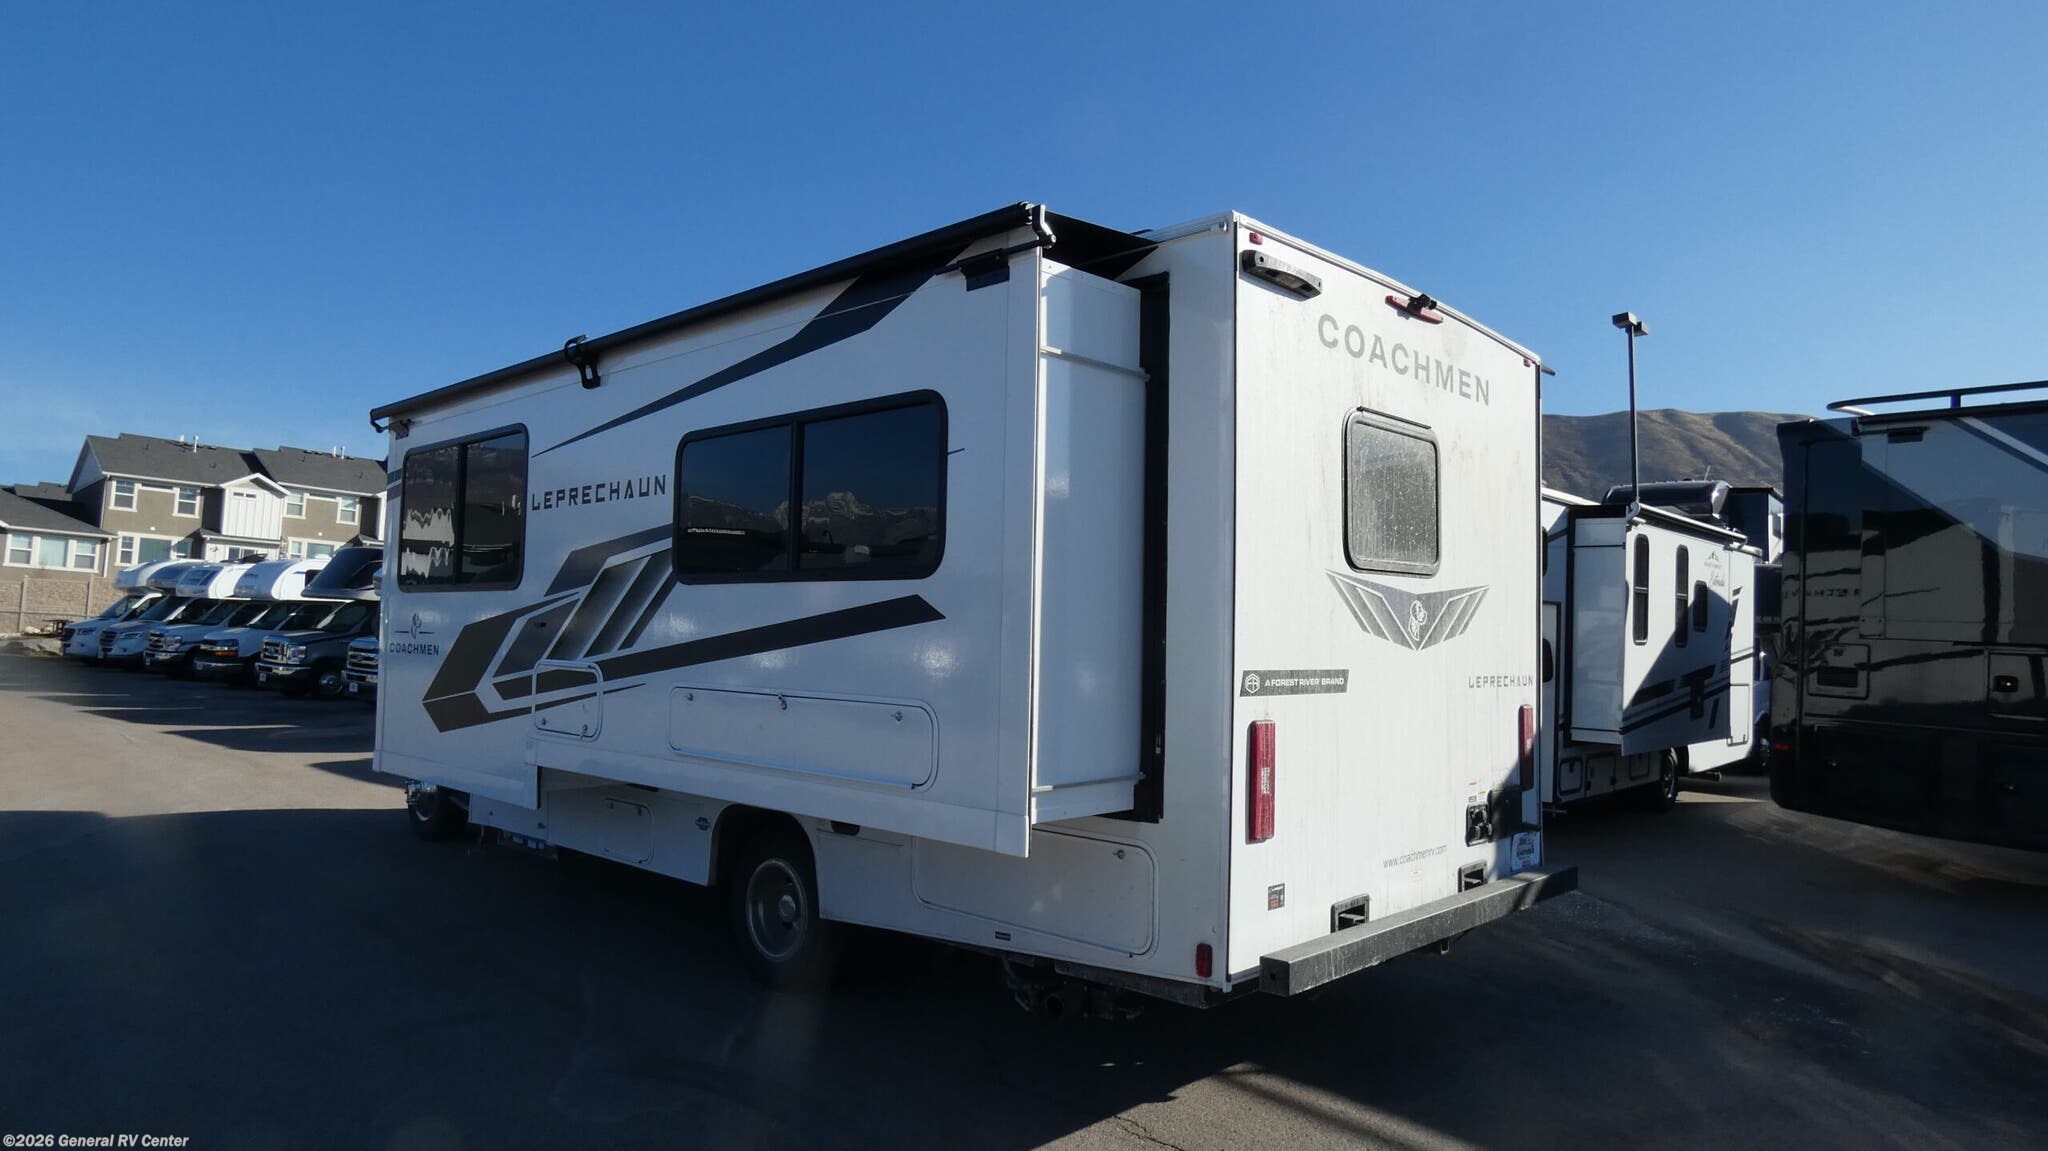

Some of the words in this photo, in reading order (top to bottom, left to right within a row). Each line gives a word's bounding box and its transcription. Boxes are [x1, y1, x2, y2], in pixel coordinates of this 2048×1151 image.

[1318, 313, 1489, 406] COACHMEN
[531, 474, 667, 511] LEPRECHAUN
[389, 642, 440, 656] COACHMEN
[1264, 679, 1271, 687] A
[1271, 679, 1298, 687] FOREST
[1299, 678, 1320, 686] RIVER
[1321, 677, 1344, 685] BRAND
[1468, 675, 1533, 688] LEPRECHAUN
